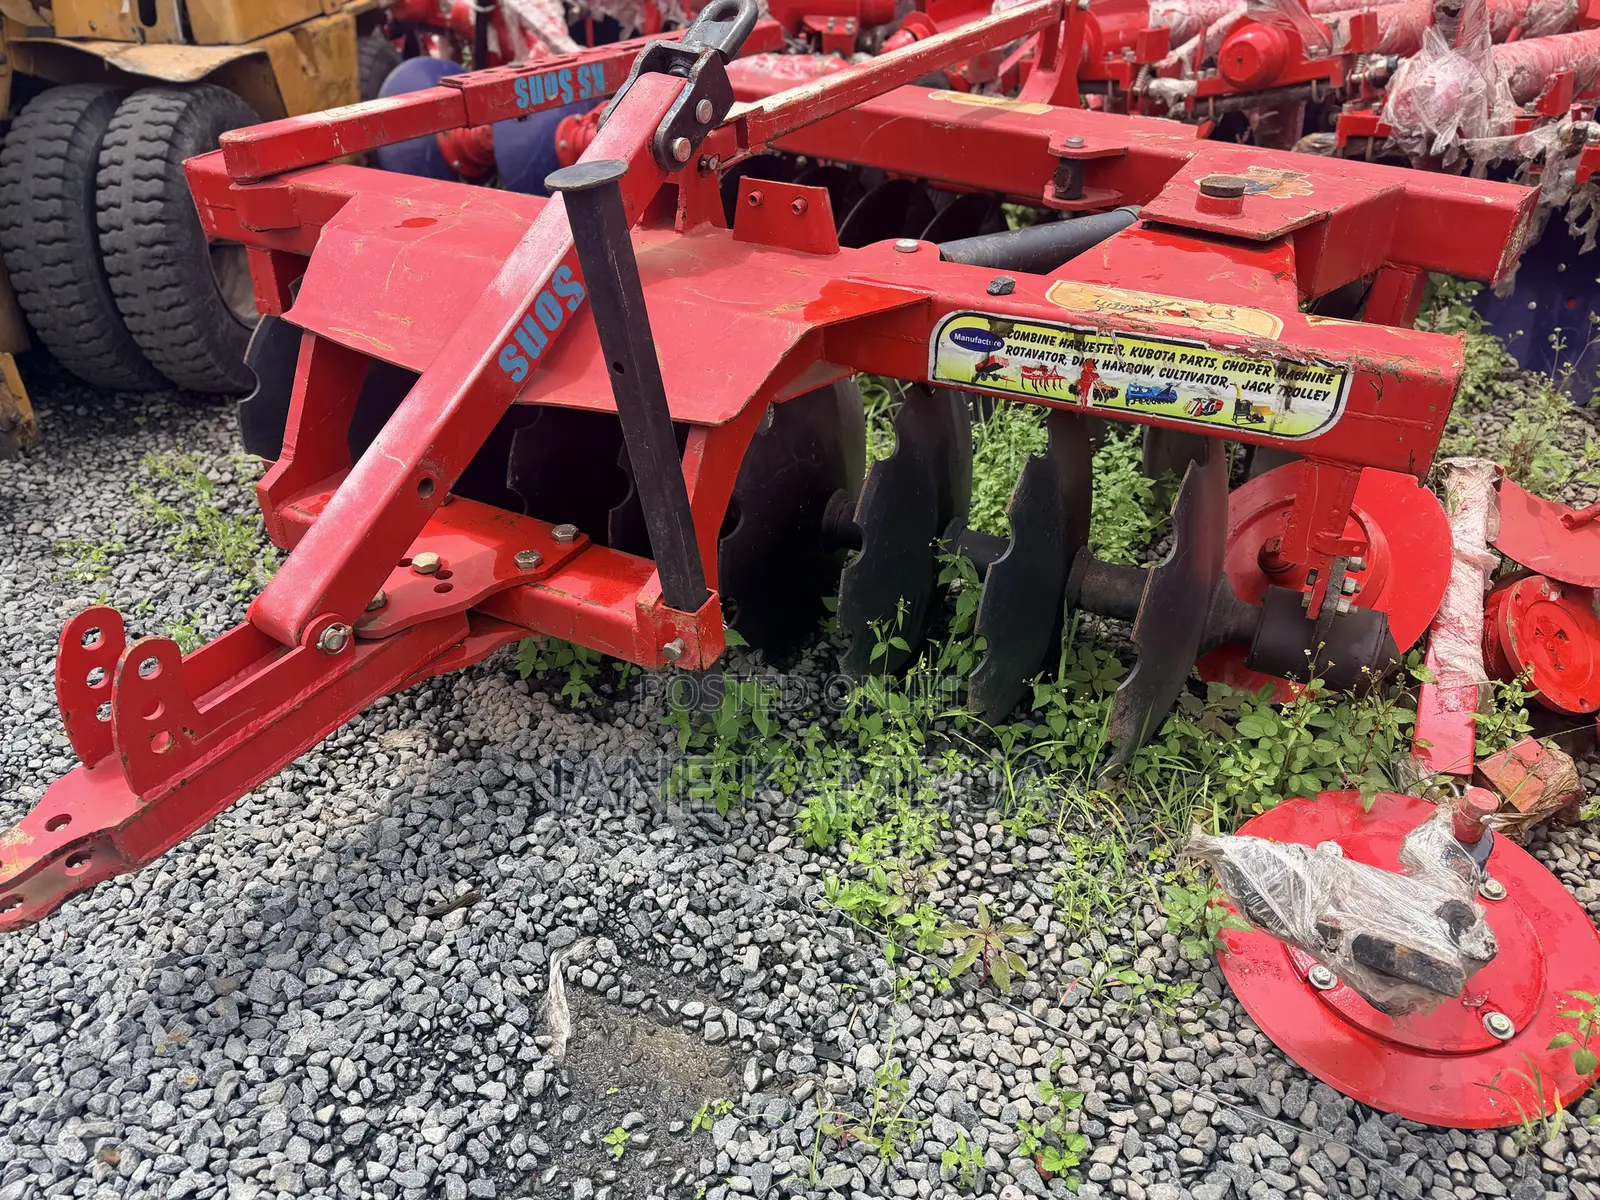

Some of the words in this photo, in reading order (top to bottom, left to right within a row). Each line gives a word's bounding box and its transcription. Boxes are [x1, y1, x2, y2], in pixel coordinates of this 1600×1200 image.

[514, 68, 574, 109] Sons
[498, 264, 586, 383] Sons
[1005, 345, 1068, 367] ROTAVATOR,
[1071, 355, 1100, 370] DIK
[1158, 367, 1230, 390] CULTIVATOR,
[1241, 379, 1275, 395] JACK
[1007, 329, 1058, 346] COMBINE
[1129, 346, 1177, 363] KUBOTA
[1178, 353, 1218, 371] PARTS,
[1222, 359, 1273, 378] CHOPER
